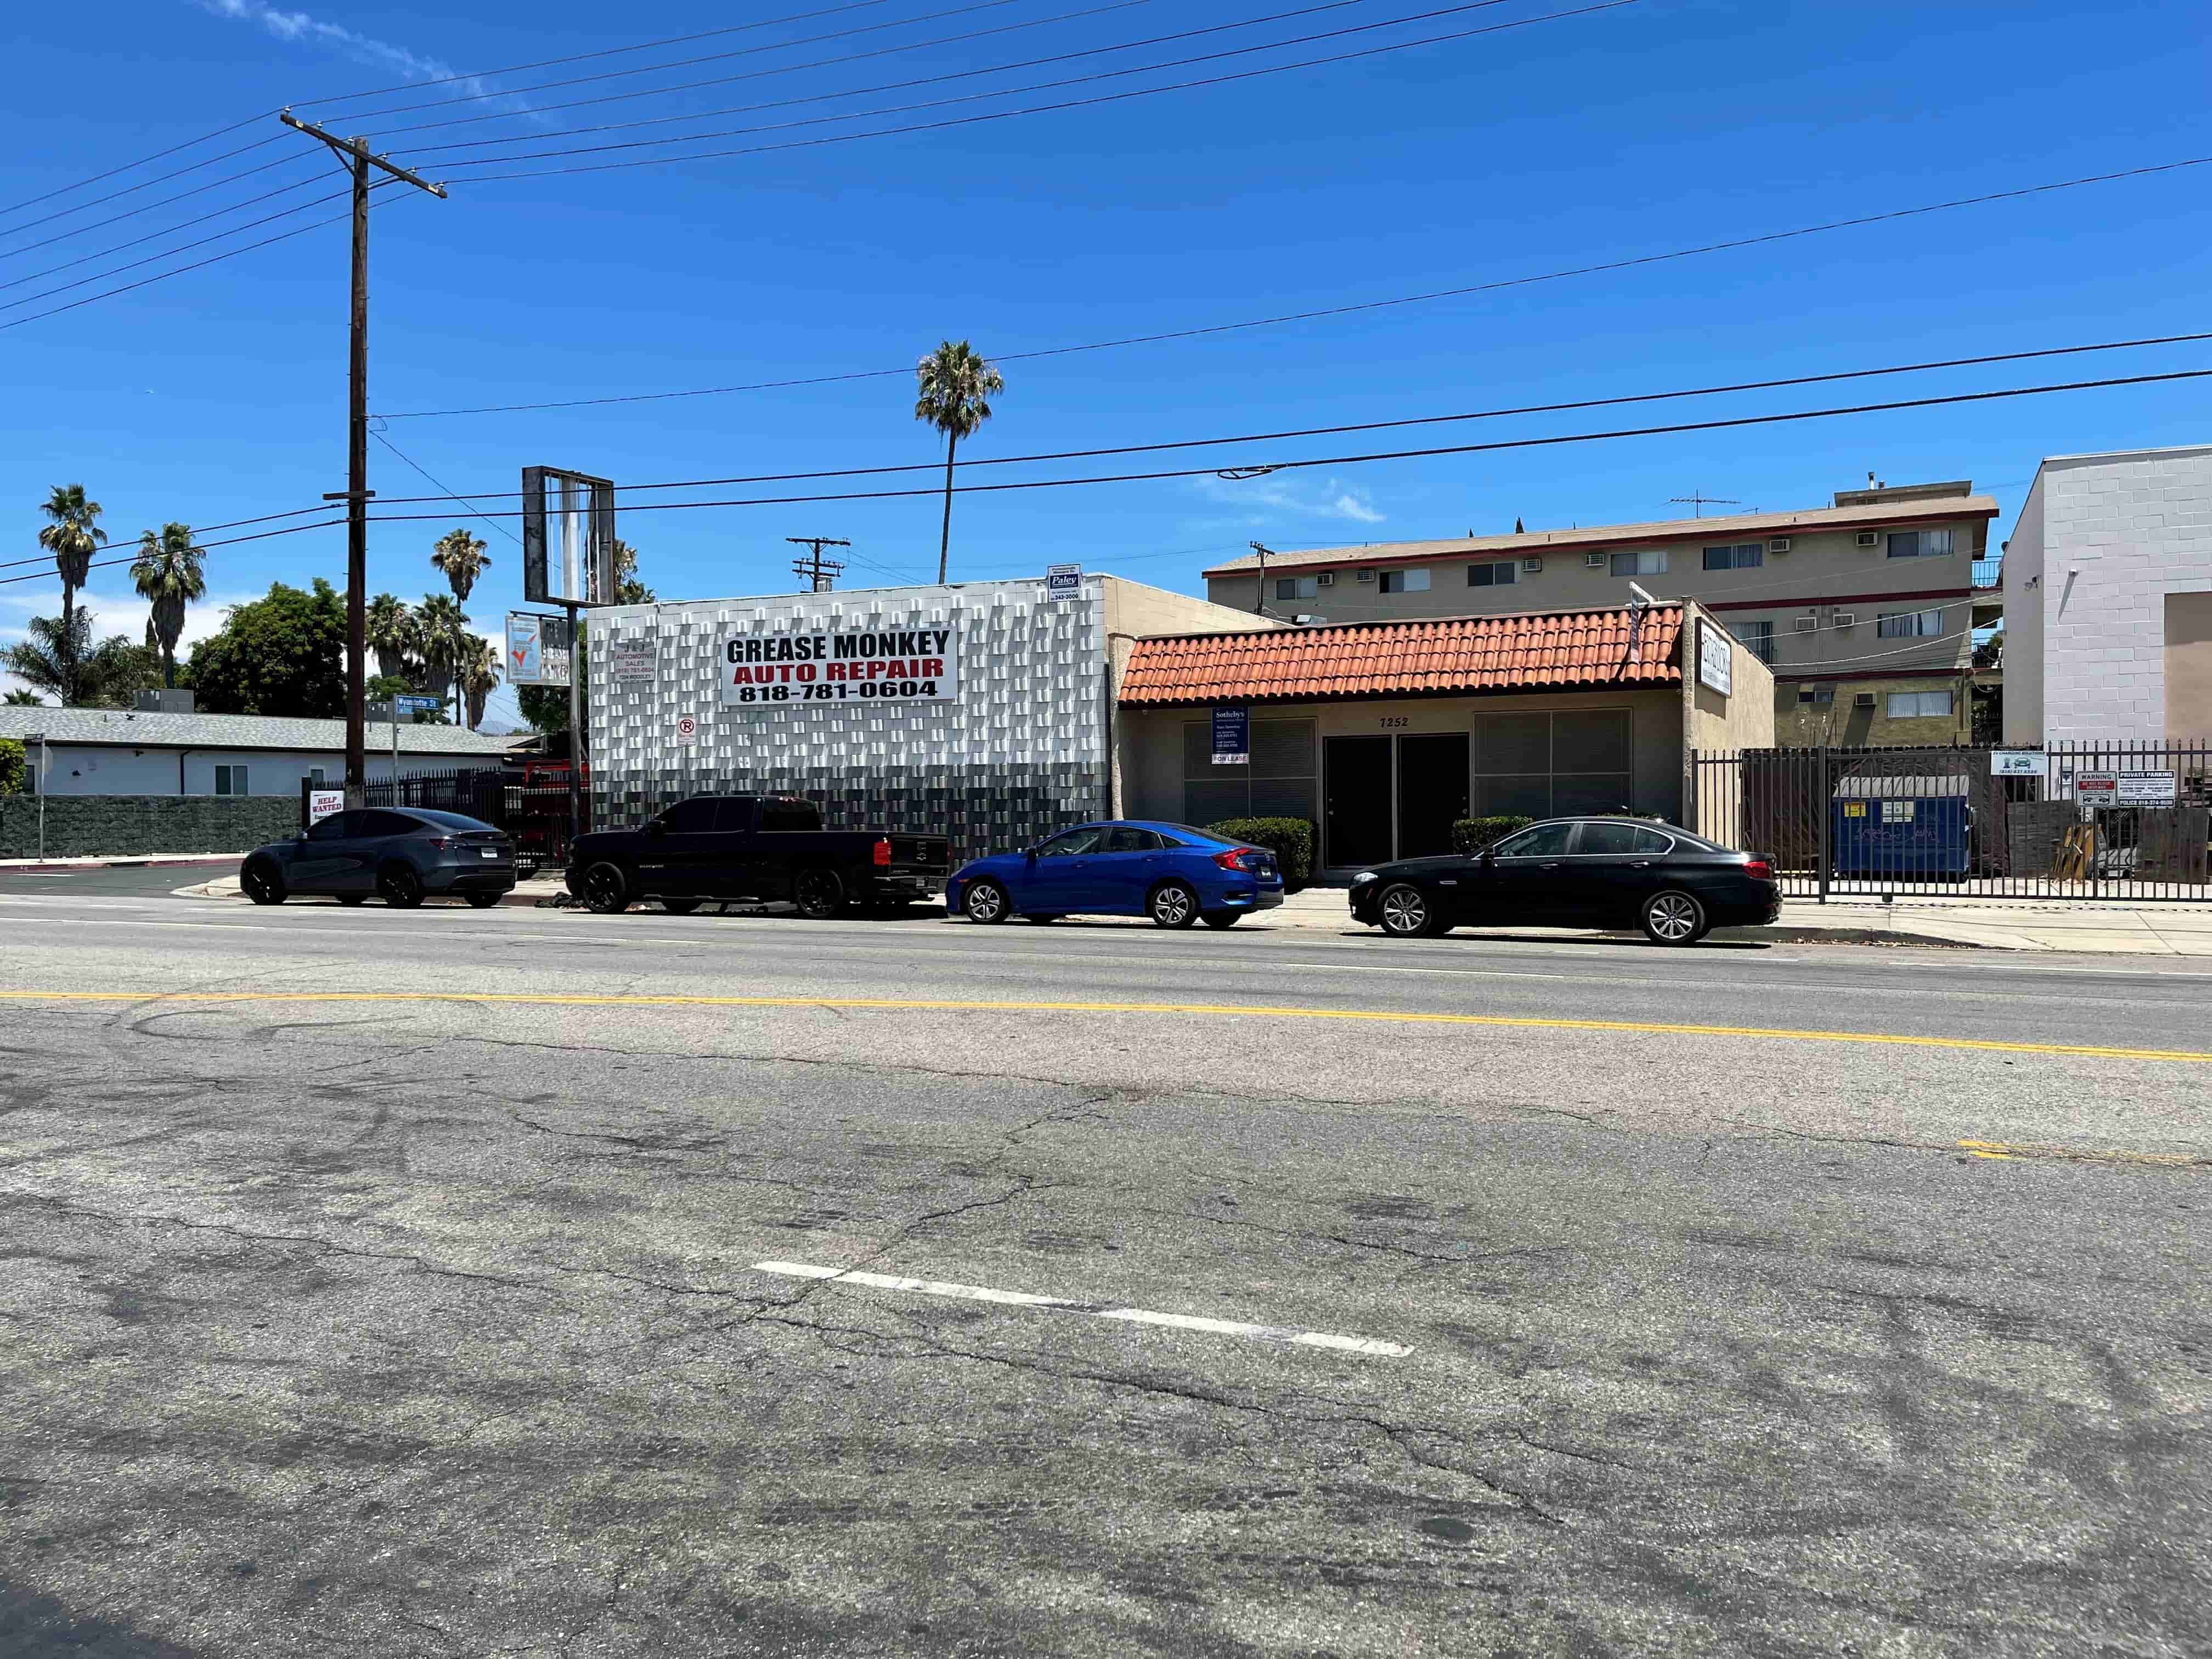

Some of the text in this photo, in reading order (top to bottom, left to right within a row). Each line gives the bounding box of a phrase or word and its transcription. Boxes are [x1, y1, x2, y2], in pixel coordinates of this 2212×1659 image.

[1052, 575, 1076, 584] Paley
[640, 644, 645, 652] J
[727, 630, 950, 663] GREASE MONKEY
[733, 658, 944, 685] AUTO REPAIR
[740, 681, 938, 702] 818-781-0604
[1216, 710, 1245, 719] Sotheby's
[1380, 717, 1408, 728] 7252
[318, 796, 338, 805] HELP
[312, 803, 342, 812] WANTED
